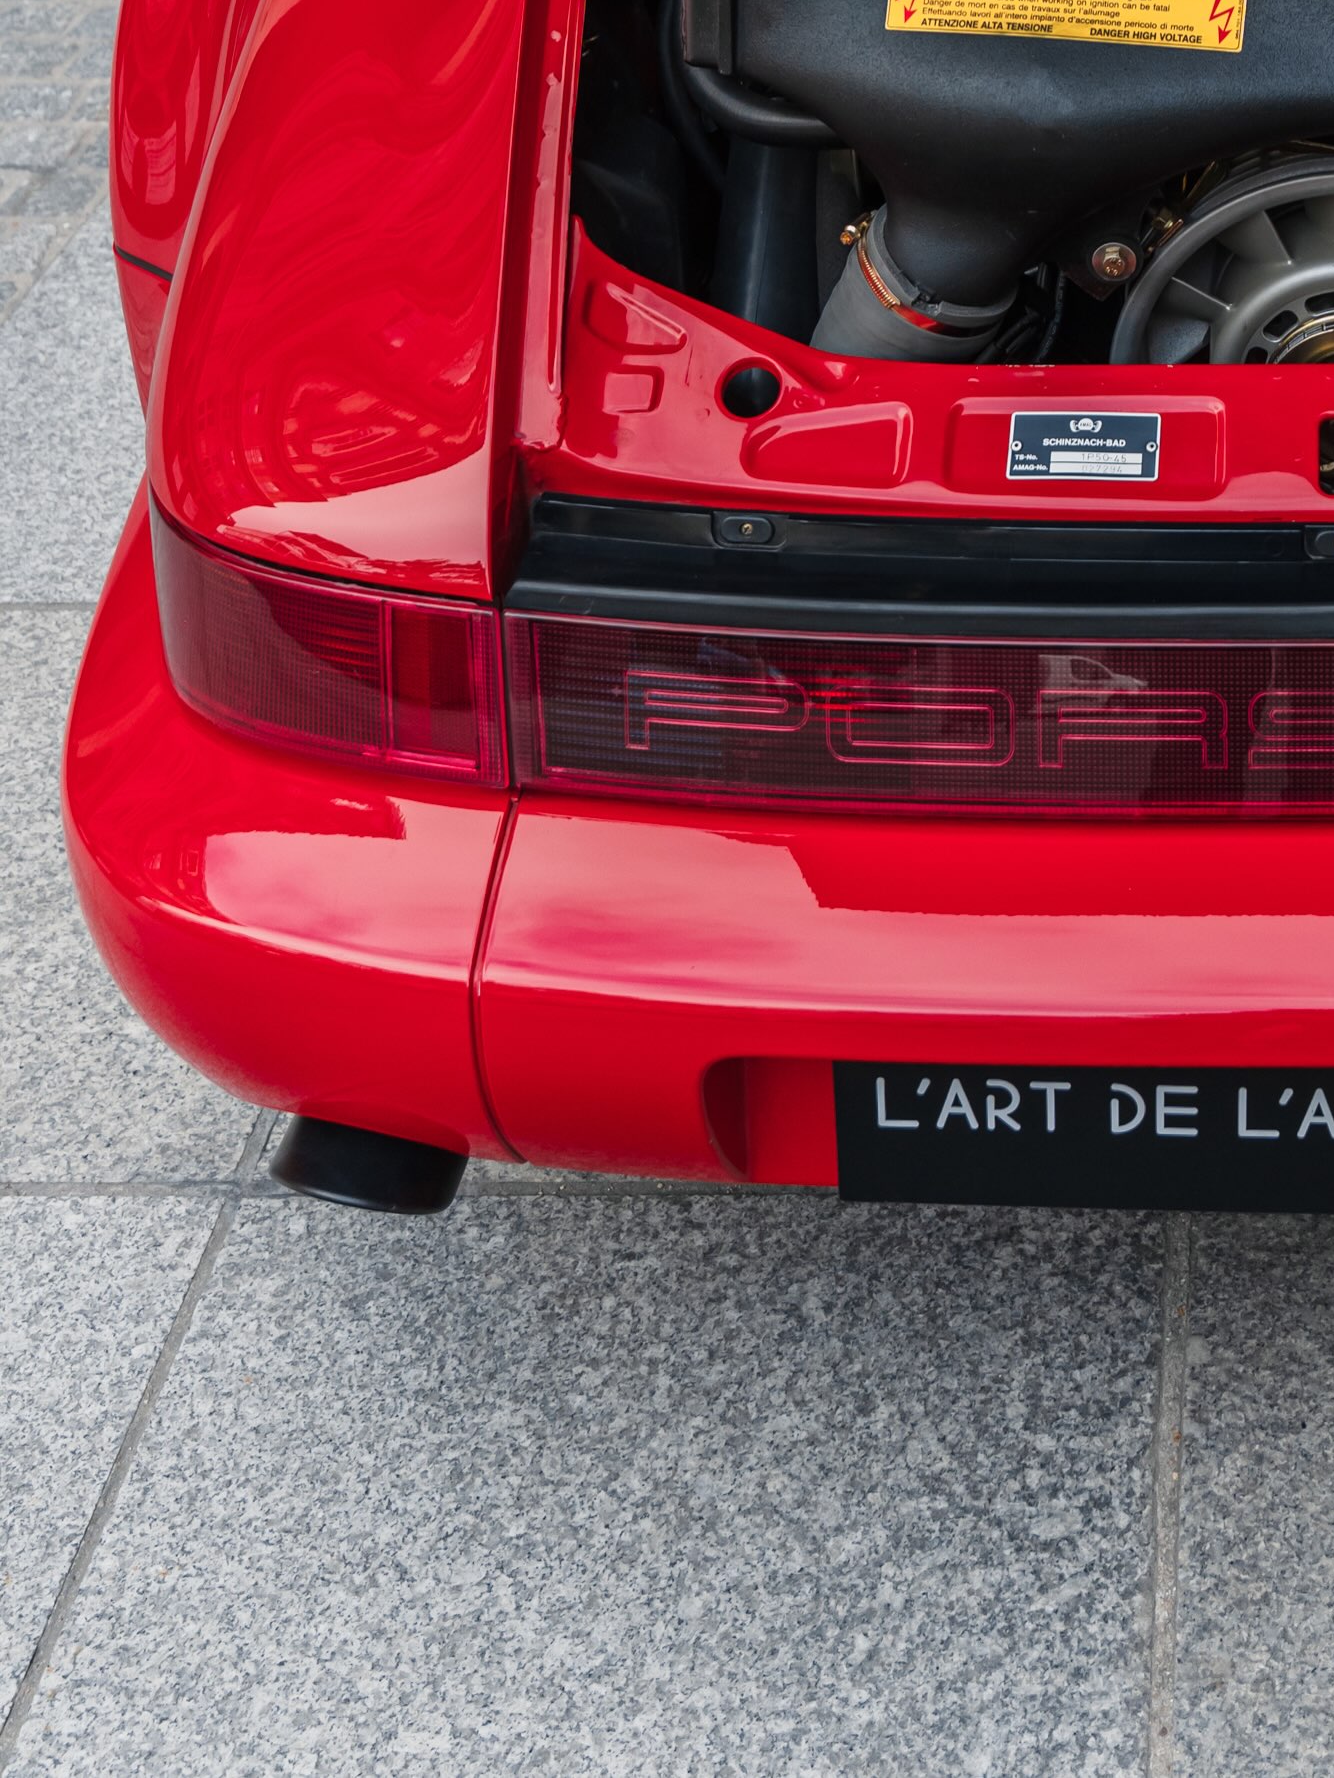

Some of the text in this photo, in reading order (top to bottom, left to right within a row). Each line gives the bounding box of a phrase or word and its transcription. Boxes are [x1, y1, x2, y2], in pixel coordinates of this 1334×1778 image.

[968, 1, 986, 9] mort
[1019, 3, 1028, 11] de
[1032, 4, 1060, 13] travaux
[1079, 7, 1120, 17] l'allumage
[1090, 0, 1119, 10] ignition
[1153, 4, 1170, 12] fatal
[921, 18, 1053, 33] ATTENZIONE ALTA TENSIONE
[923, 7, 967, 17] Effettuando
[970, 10, 991, 18] lavori
[1030, 13, 1065, 23] impianto
[1068, 16, 1121, 26] d'accensione
[1124, 20, 1157, 30] pericolo
[1160, 22, 1168, 30] di
[1171, 24, 1194, 32] morte
[1090, 28, 1202, 44] DANGER HIGH VOLTAGE
[1043, 438, 1126, 447] SCHINZNACH-BAD
[876, 1077, 1072, 1132] L'ART
[1110, 1083, 1199, 1137] DE
